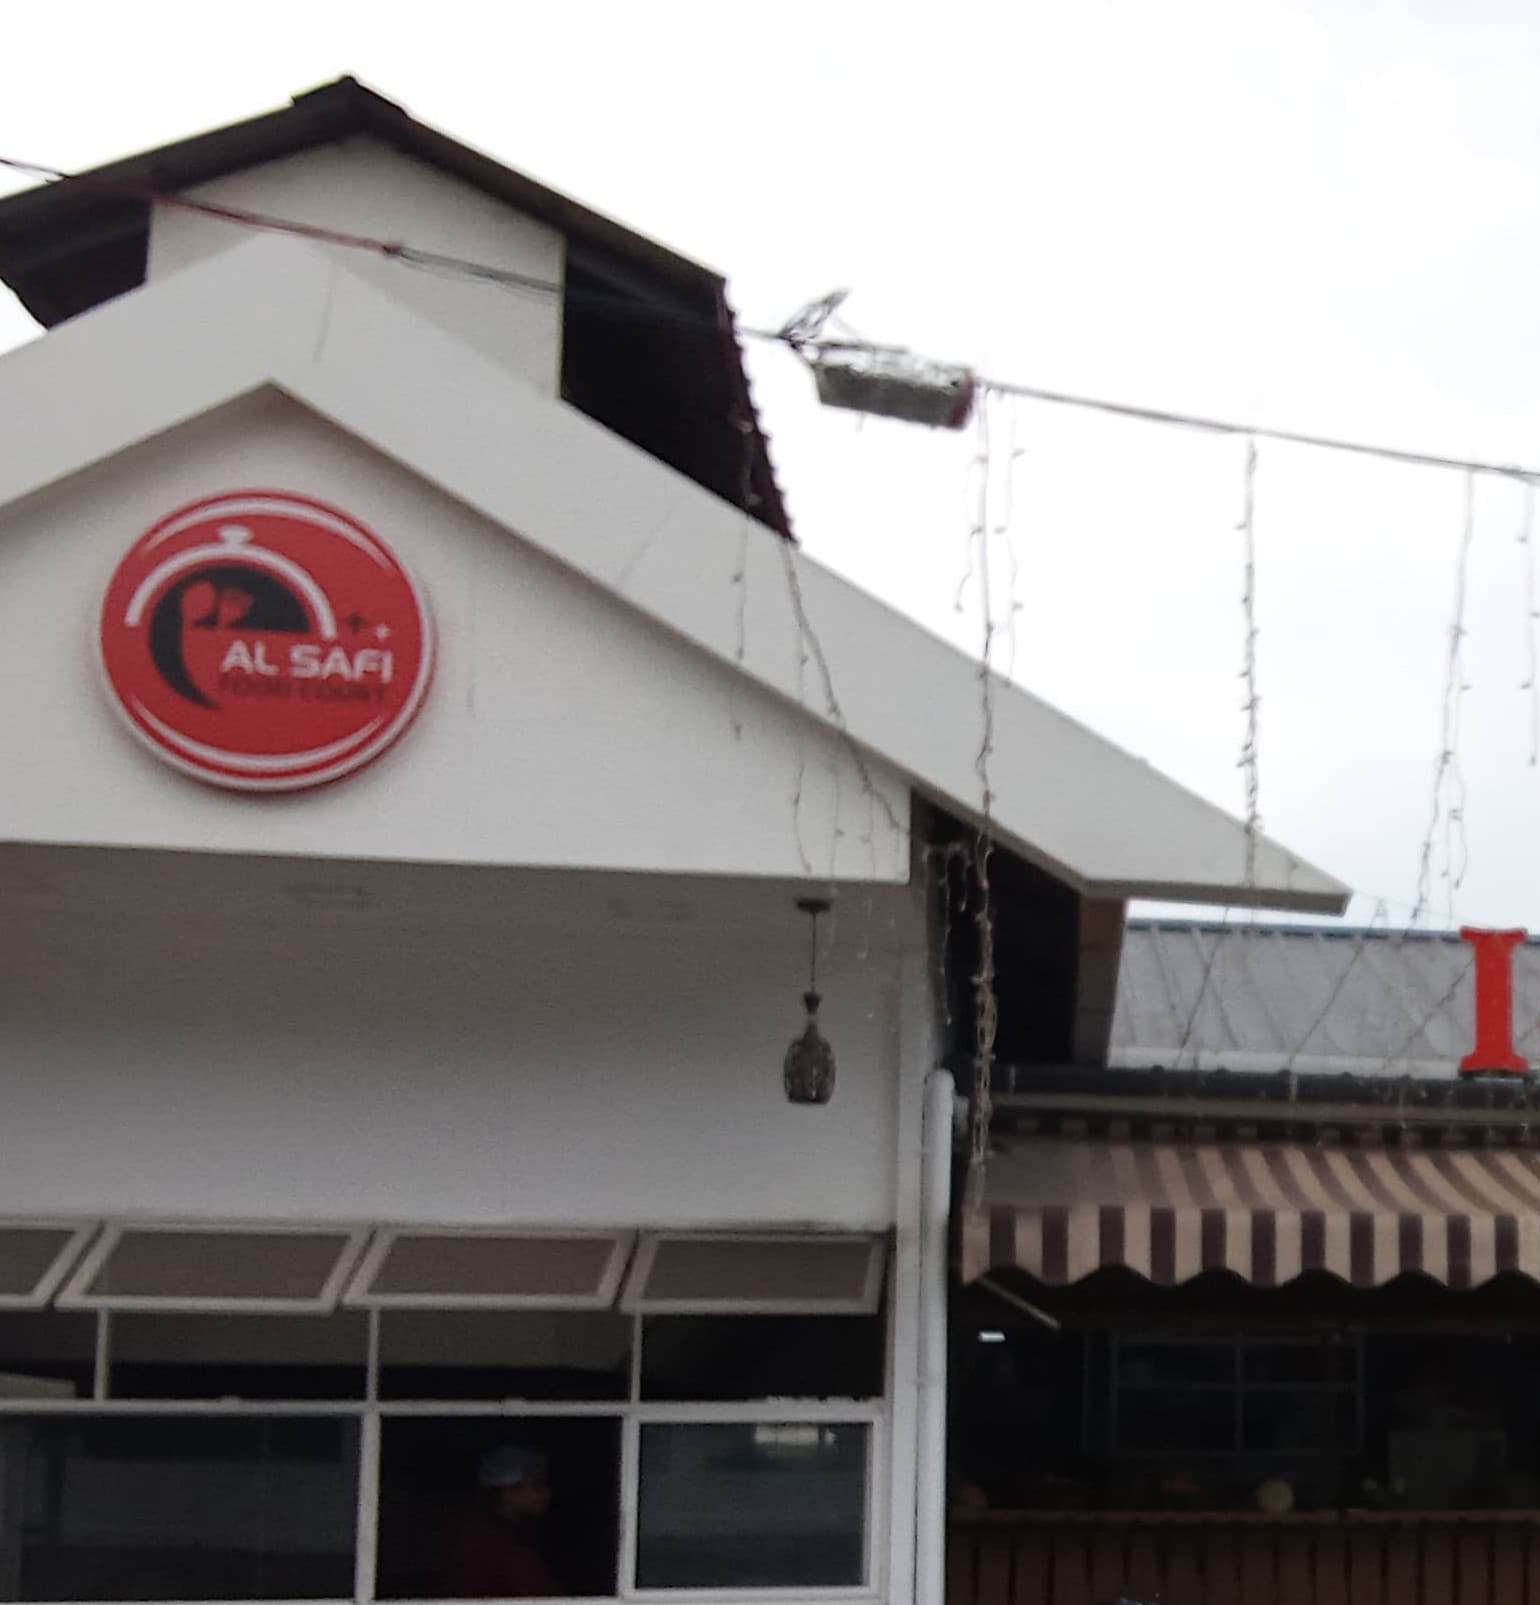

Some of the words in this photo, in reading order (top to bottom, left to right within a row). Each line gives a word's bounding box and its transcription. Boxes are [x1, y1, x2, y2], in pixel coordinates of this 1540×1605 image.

[221, 639, 280, 676] AL
[289, 644, 394, 684] SAFI
[1460, 927, 1528, 1073] I
